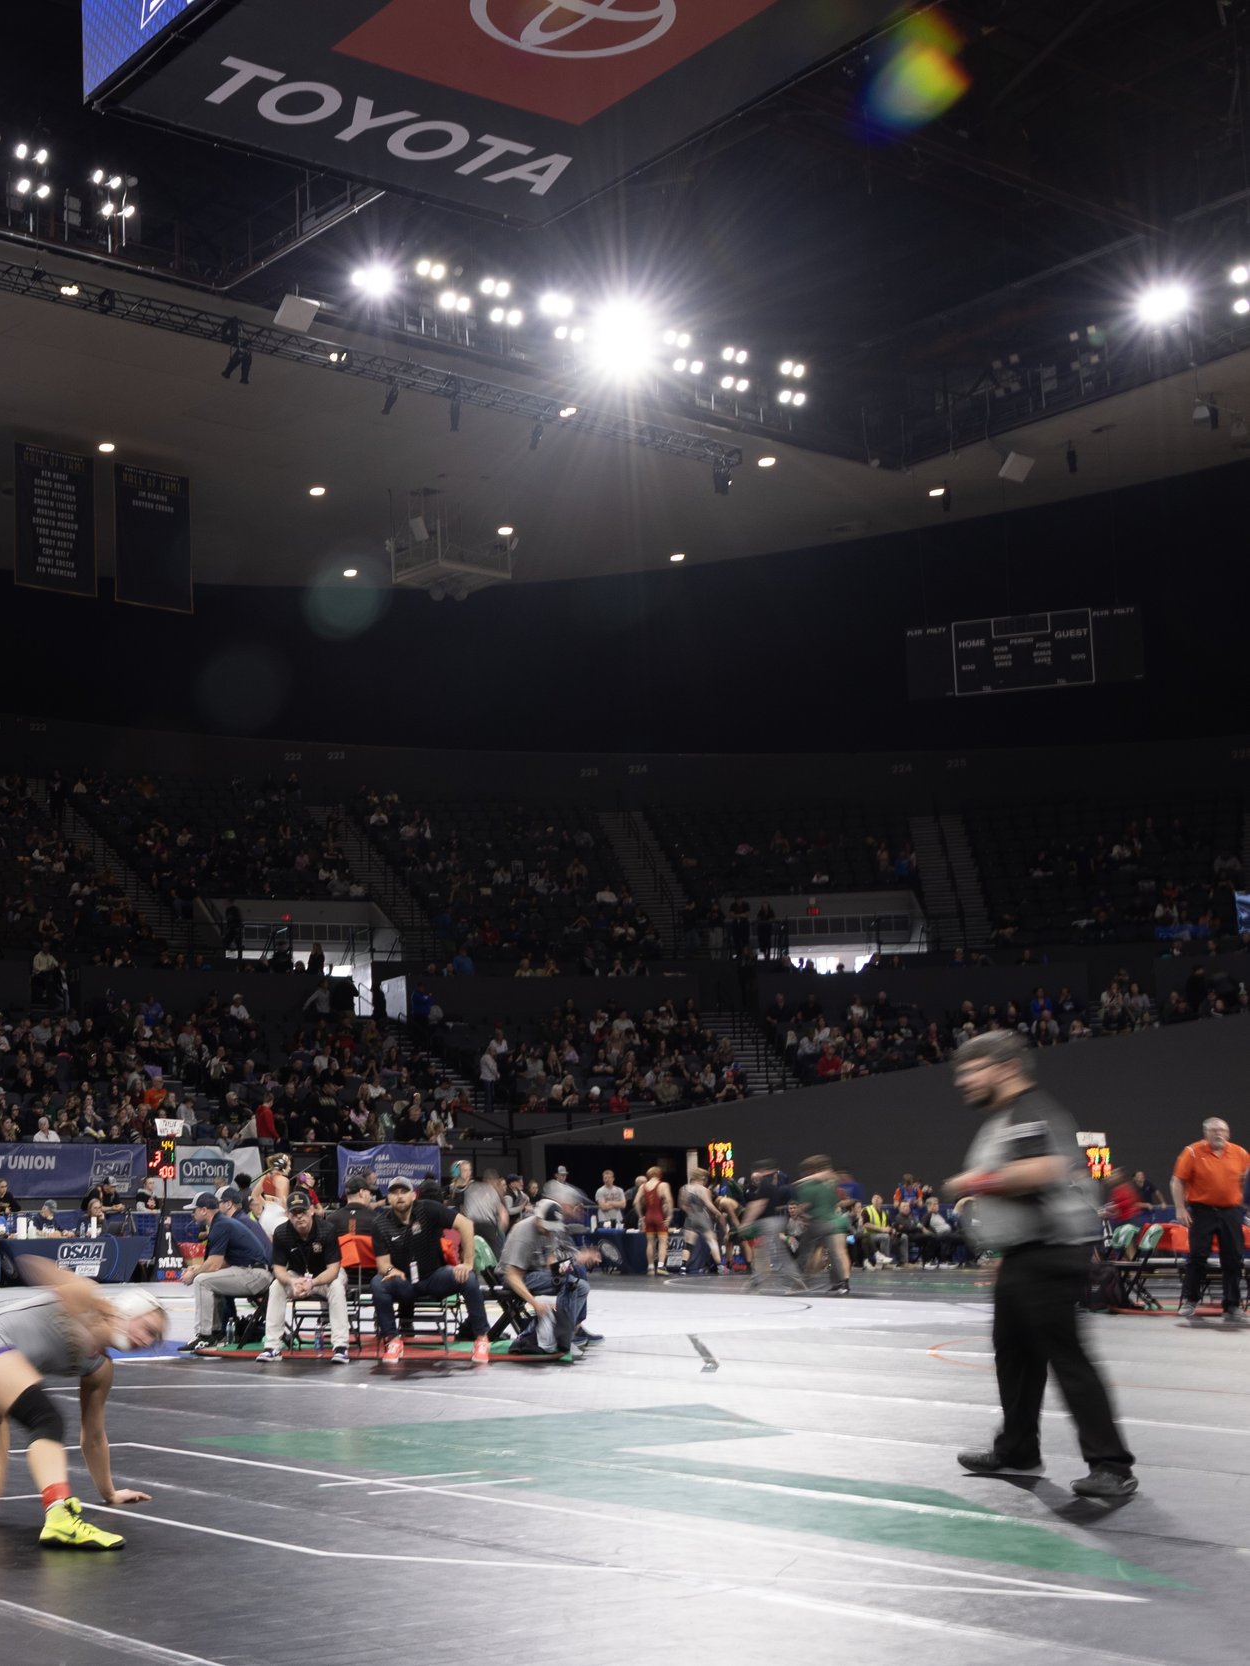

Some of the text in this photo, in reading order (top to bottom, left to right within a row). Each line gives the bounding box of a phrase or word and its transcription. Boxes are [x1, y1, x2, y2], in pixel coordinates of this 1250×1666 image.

[204, 54, 573, 196] TOYOTA
[1054, 628, 1089, 640] GUEST
[958, 638, 986, 649] HOME
[161, 1140, 175, 1151] 44
[7, 1155, 57, 1170] UNION
[91, 1160, 132, 1177] OSAA
[183, 1161, 230, 1177] OnPoint
[58, 1243, 105, 1260] OSAA
[158, 1256, 184, 1269] MAT
